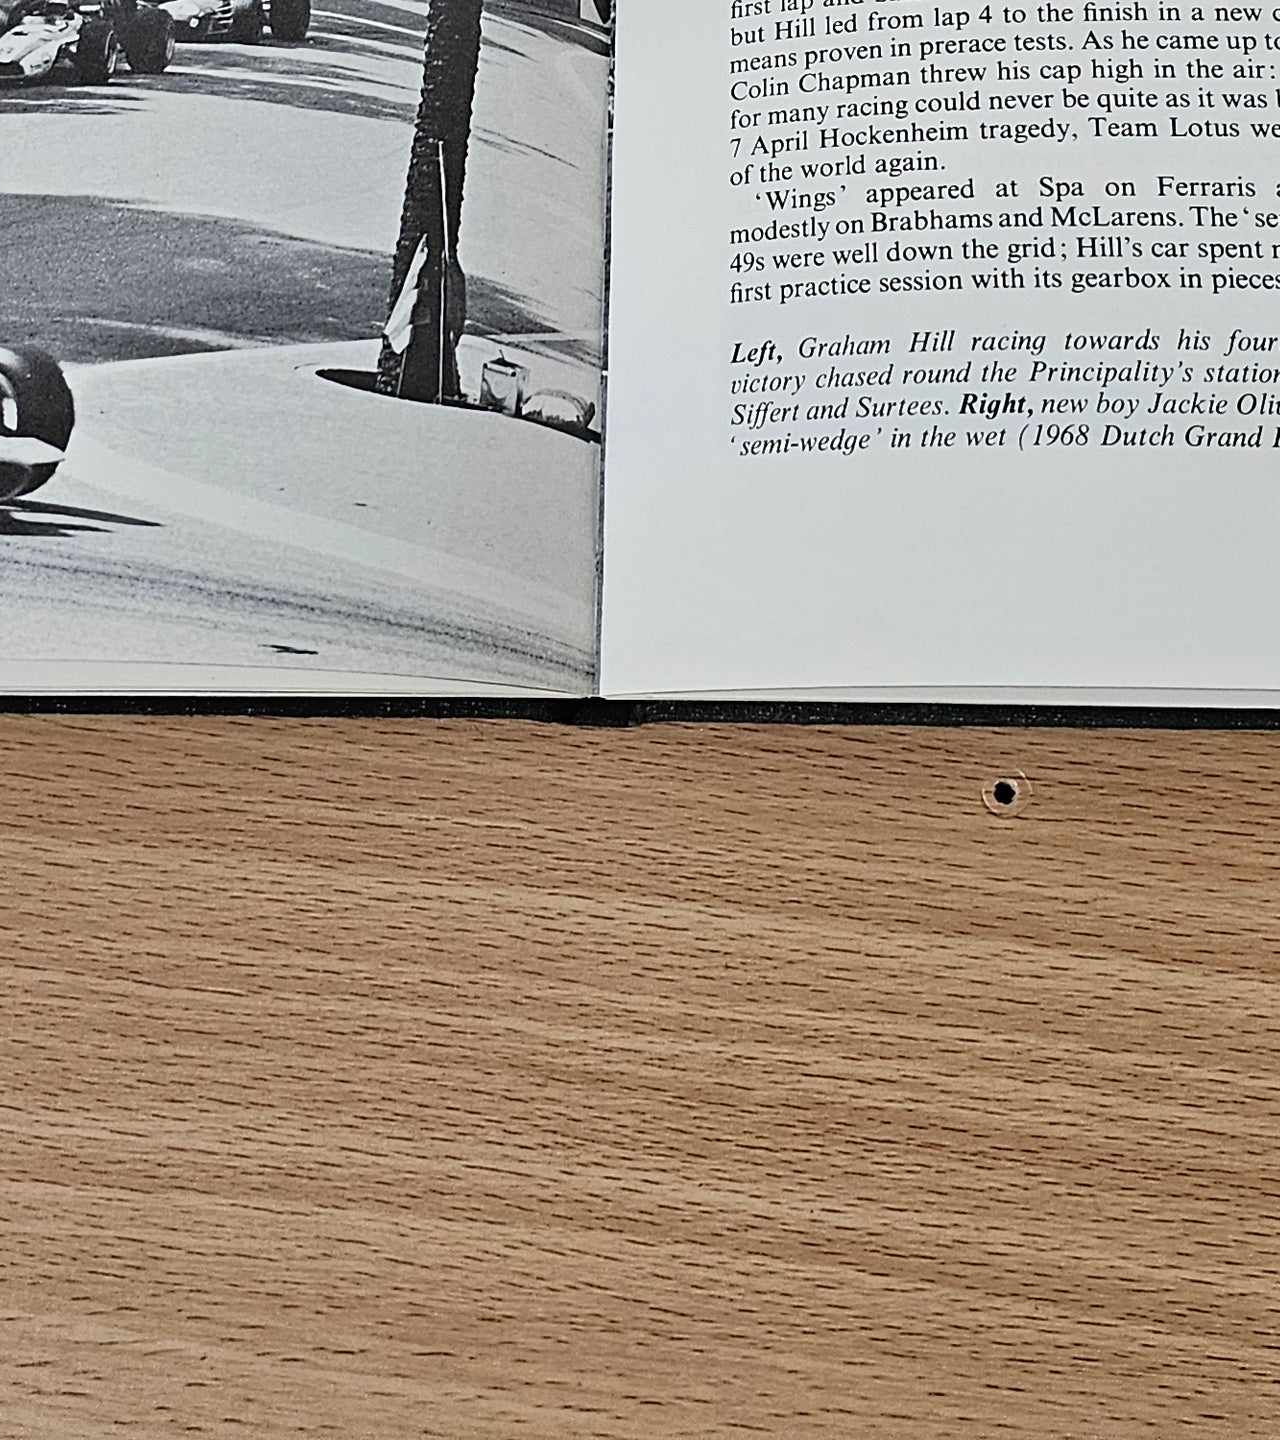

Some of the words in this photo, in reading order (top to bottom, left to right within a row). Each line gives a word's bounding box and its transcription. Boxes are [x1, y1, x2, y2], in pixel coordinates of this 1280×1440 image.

[730, 164, 754, 186] of
[760, 162, 793, 183] the
[800, 154, 866, 178] world
[875, 150, 945, 177] again.
[730, 282, 772, 304] first
[780, 273, 871, 305] practice
[879, 269, 963, 292] session
[971, 267, 1025, 289] with
[1034, 266, 1062, 288] its
[1071, 267, 1171, 293] gearbox
[1179, 266, 1203, 288] in
[730, 340, 782, 367] Left,
[799, 334, 890, 358] Graham
[909, 330, 955, 353] Hill
[971, 330, 1046, 356] racing
[1065, 328, 1160, 350] towards
[1177, 328, 1211, 351] his
[731, 401, 799, 430] Siffert
[806, 396, 849, 420] and
[855, 396, 949, 418] Surtees.
[958, 392, 1033, 420] Right,
[1041, 399, 1088, 413] new
[1096, 391, 1140, 419] boy
[1147, 392, 1228, 415] Jackie
